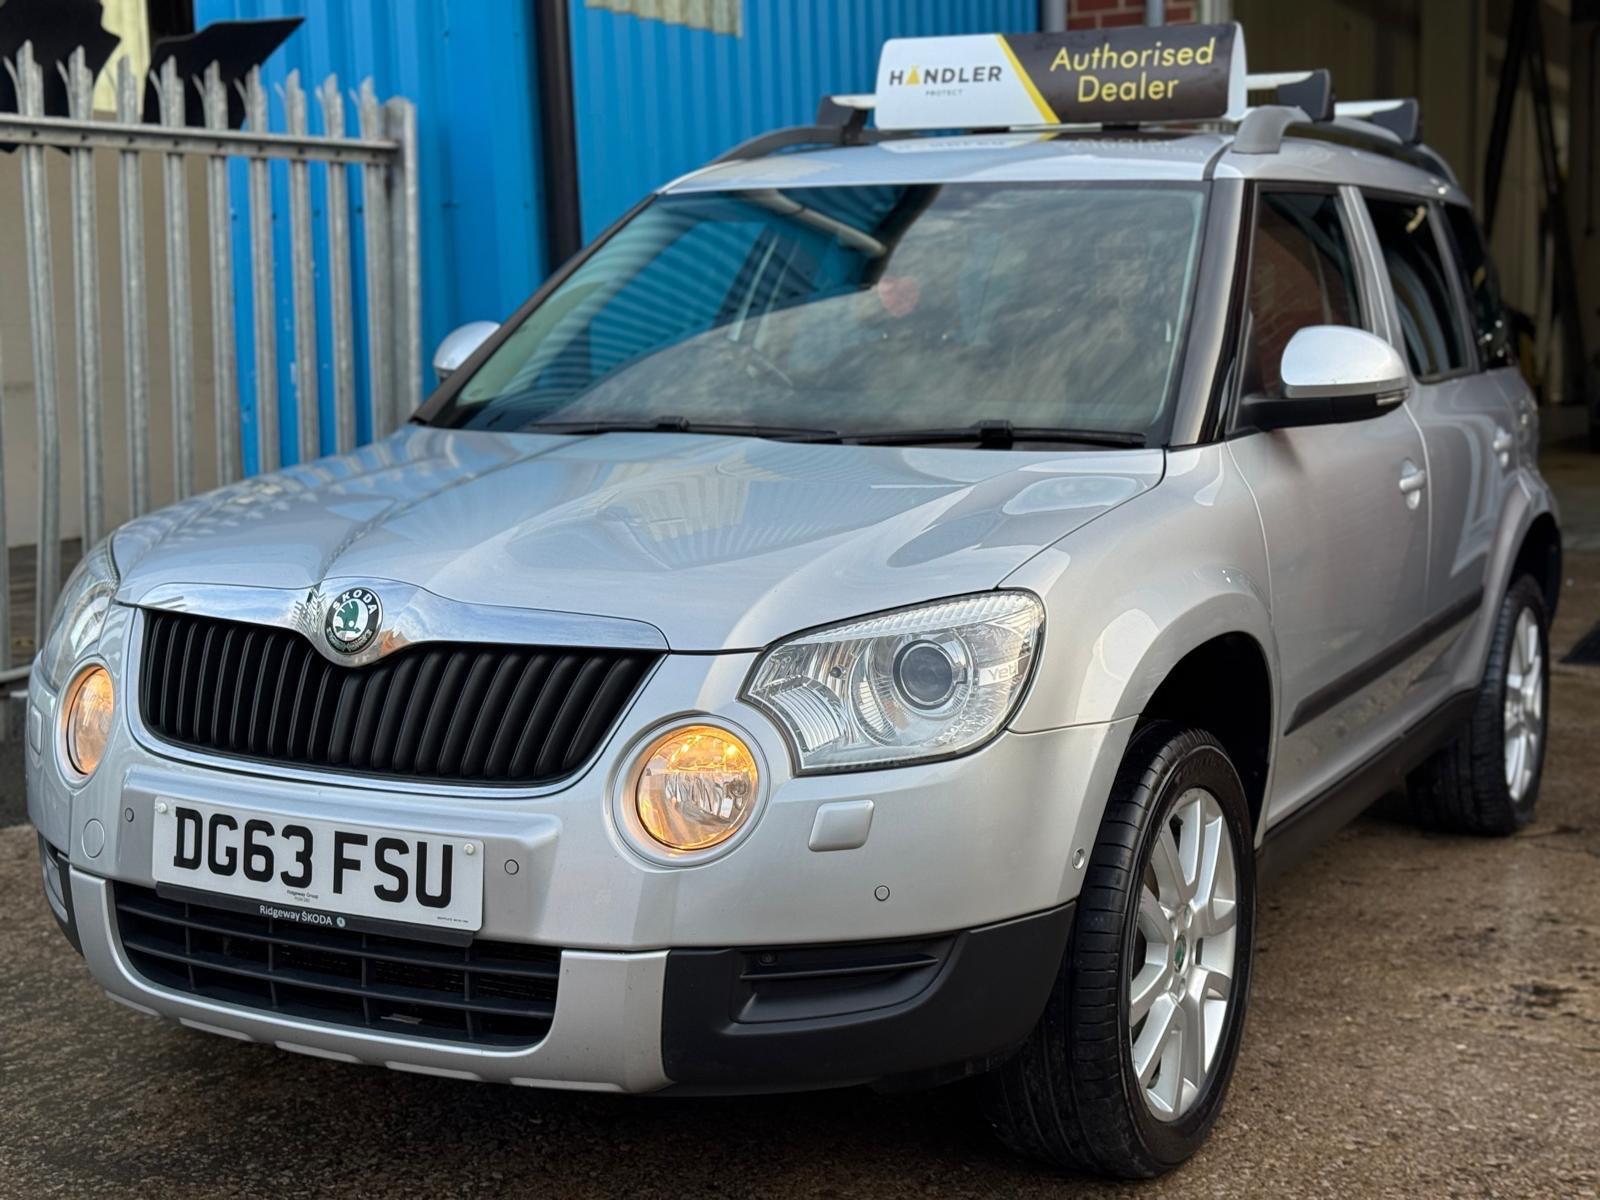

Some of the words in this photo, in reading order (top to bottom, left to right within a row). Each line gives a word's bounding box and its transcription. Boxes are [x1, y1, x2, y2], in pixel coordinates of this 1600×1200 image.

[1049, 36, 1216, 72] Authorised
[1077, 71, 1180, 103] Dealer
[173, 806, 314, 889] DG63
[333, 830, 453, 909] FSU
[259, 904, 300, 922] Ridgeway
[301, 910, 333, 926] ŠKODA
